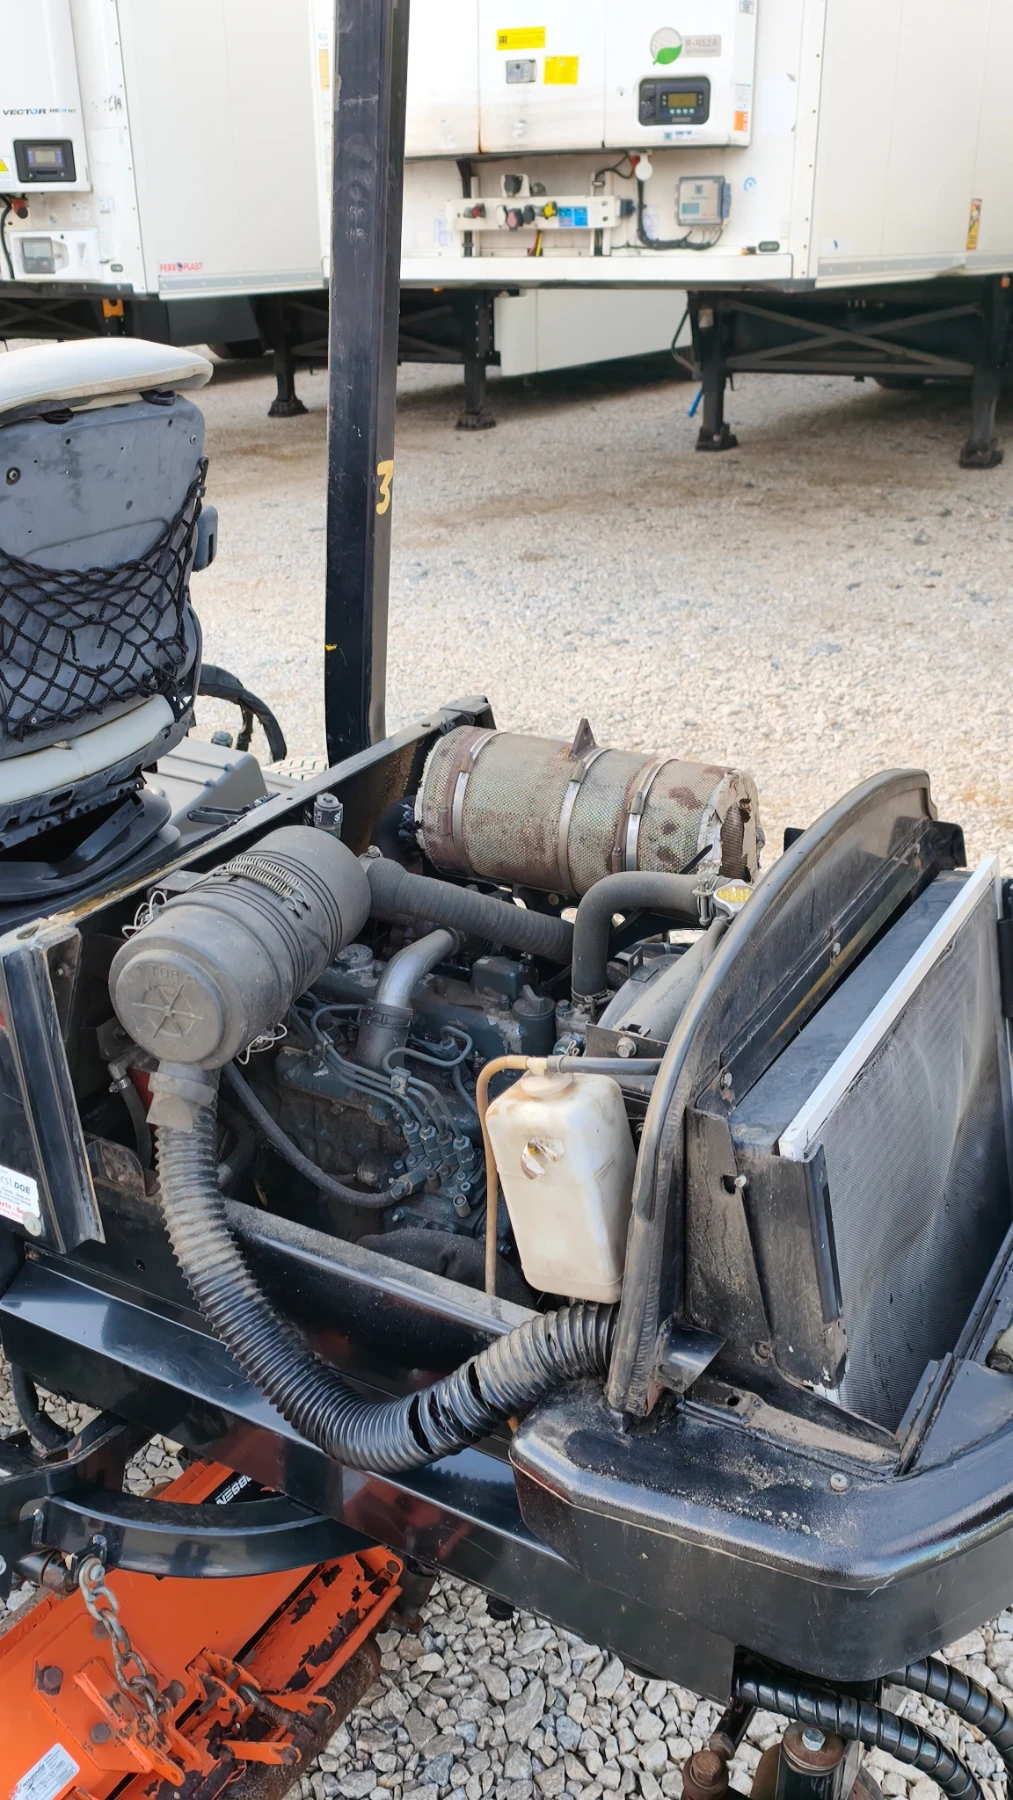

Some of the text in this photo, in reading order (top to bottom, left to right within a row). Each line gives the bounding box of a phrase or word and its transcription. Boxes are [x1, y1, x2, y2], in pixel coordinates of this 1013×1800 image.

[2, 108, 47, 116] VECTOR
[376, 460, 393, 515] 3
[14, 1181, 30, 1194] DOE
